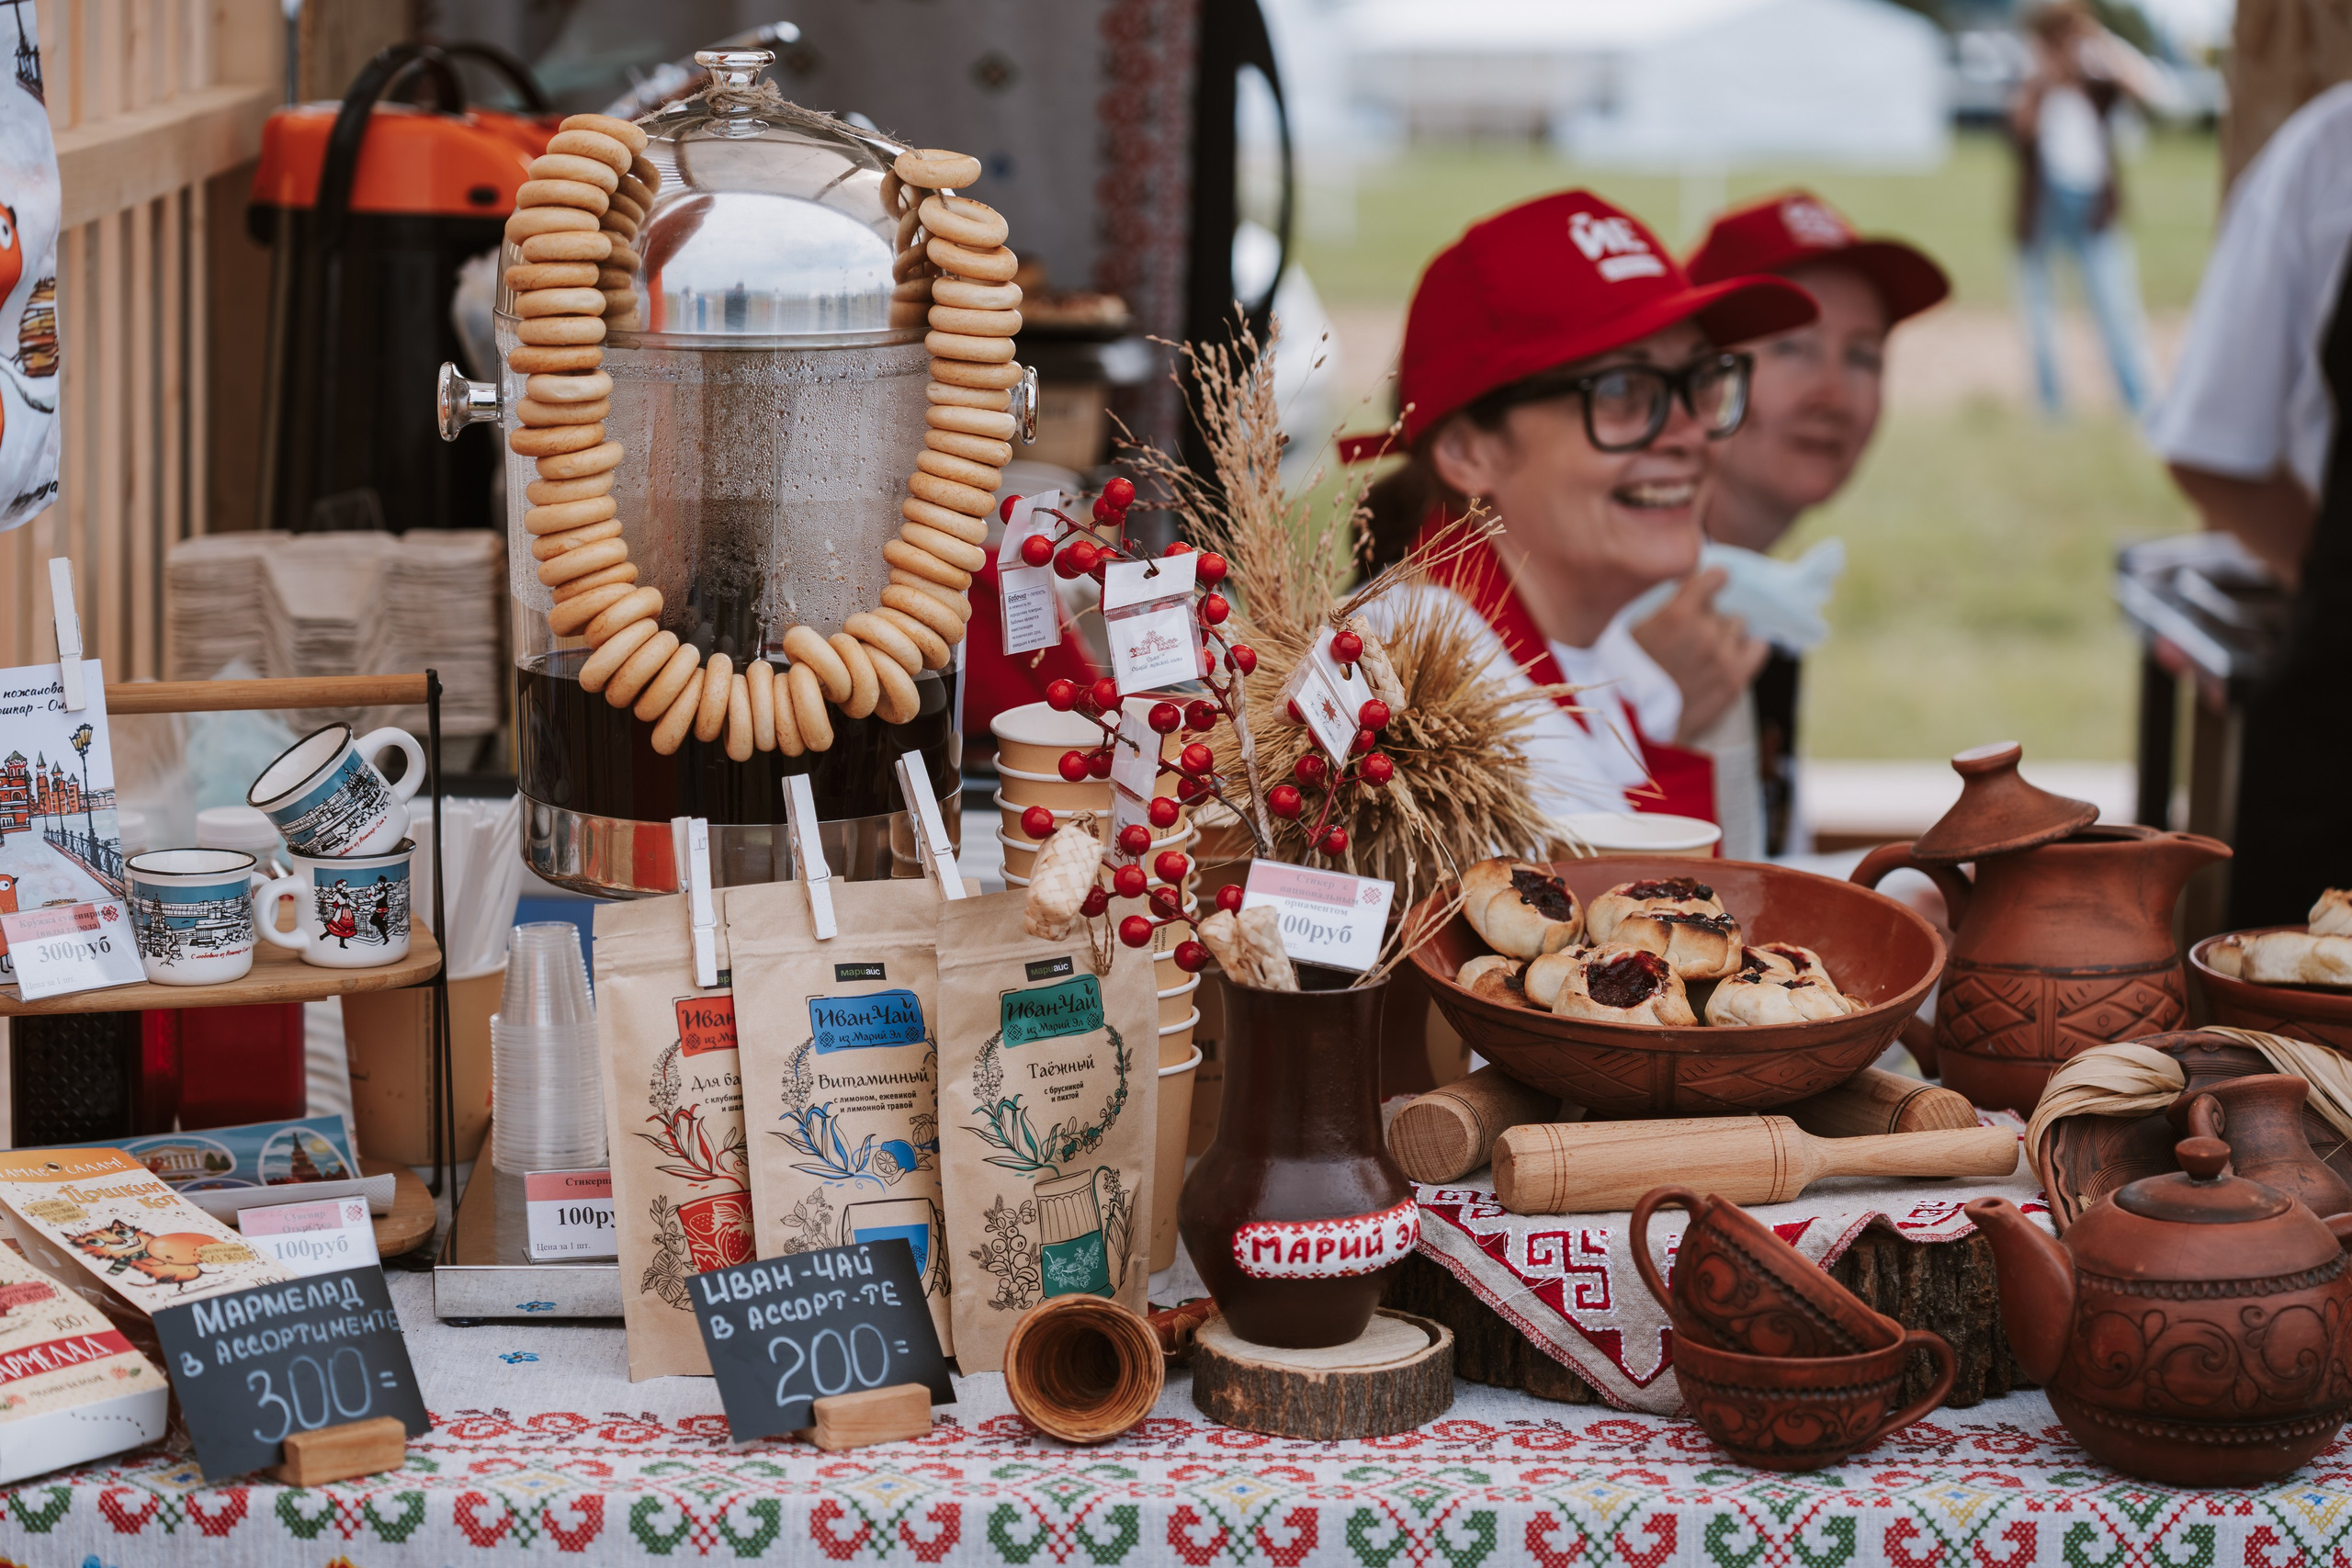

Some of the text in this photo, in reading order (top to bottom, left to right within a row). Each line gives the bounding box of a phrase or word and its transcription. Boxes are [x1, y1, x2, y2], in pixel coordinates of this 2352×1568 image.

[3, 681, 65, 699] пожалова
[1296, 874, 1335, 889] Стикер
[1279, 886, 1360, 906] национальным
[1284, 898, 1349, 917] орнаментом
[18, 918, 57, 929] Кружка
[37, 922, 101, 939] (виды города)
[37, 935, 111, 964] 300руб
[840, 966, 881, 977] мариайс
[1031, 962, 1069, 976] мариайс
[25, 980, 46, 990] Цена
[1006, 983, 1098, 1022] Иван-Чай
[682, 1010, 736, 1031] Иван
[815, 998, 918, 1029] Иван-Чай
[1026, 1018, 1084, 1038] из Марий Эл
[705, 1036, 716, 1047] из
[839, 1030, 902, 1047] из Марий Эл
[1026, 1055, 1095, 1079] Таёжный
[692, 1073, 741, 1093] Для ба
[819, 1066, 930, 1090] Витаминный
[1049, 1081, 1084, 1094] брусникой
[710, 1093, 743, 1105] клубник
[840, 1094, 878, 1104] лимоном,
[879, 1090, 917, 1100] ежевикой
[1057, 1091, 1080, 1102] пихтой
[728, 1103, 744, 1111] шал
[846, 1103, 885, 1113] лимонной
[887, 1102, 913, 1111] травой
[65, 1156, 128, 1175] САЛАМ!
[284, 1211, 326, 1223] Сувенир
[282, 1223, 333, 1235] Открытка
[274, 1235, 349, 1260] 100руб
[537, 1243, 558, 1252] Цена
[1251, 1226, 1384, 1264] МАРИЙ
[214, 1309, 401, 1366] АССОРТИМЕНТЕ
[0, 1335, 114, 1385] АРМЕЛАД
